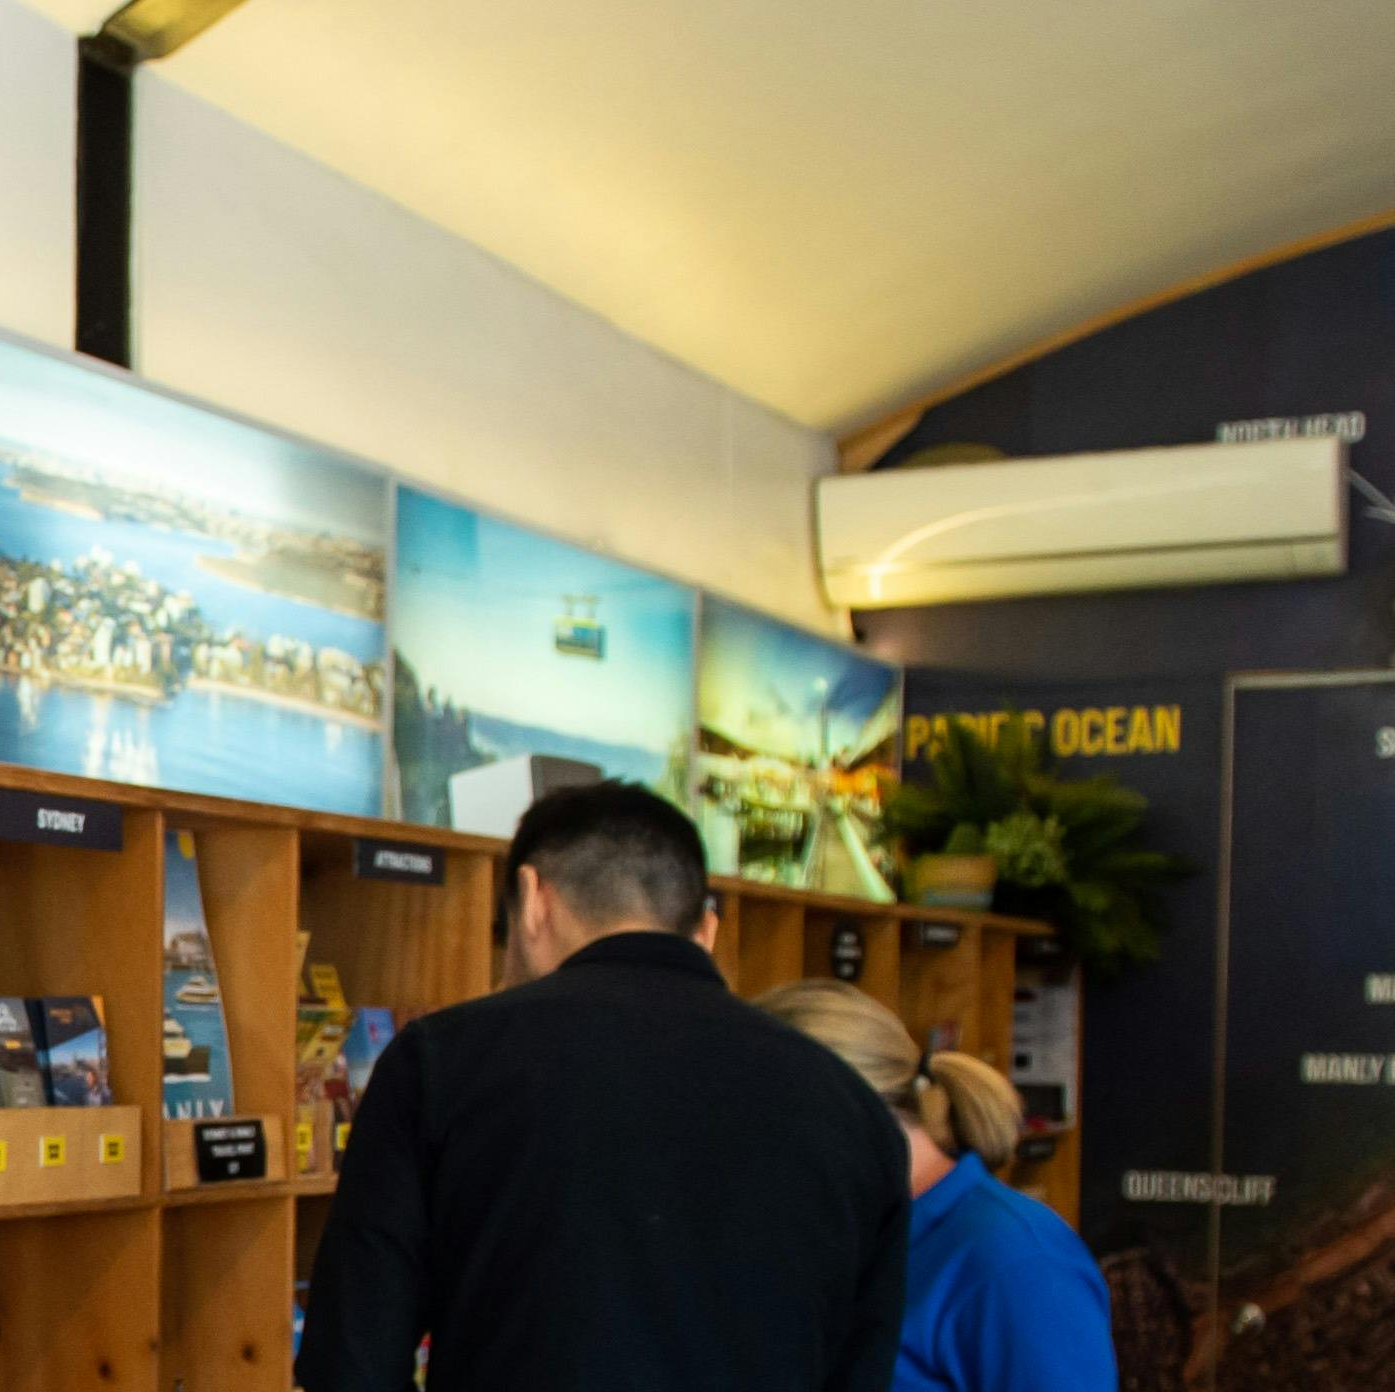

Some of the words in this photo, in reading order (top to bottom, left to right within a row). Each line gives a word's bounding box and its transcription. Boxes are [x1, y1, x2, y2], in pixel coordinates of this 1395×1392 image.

[1050, 704, 1183, 758] OCEAN
[36, 807, 86, 834] SYDNEY
[373, 849, 433, 875] ATTRACTIONS
[1299, 1051, 1385, 1085] MANLY
[1121, 1169, 1278, 1206] QUEENSCLIFF
